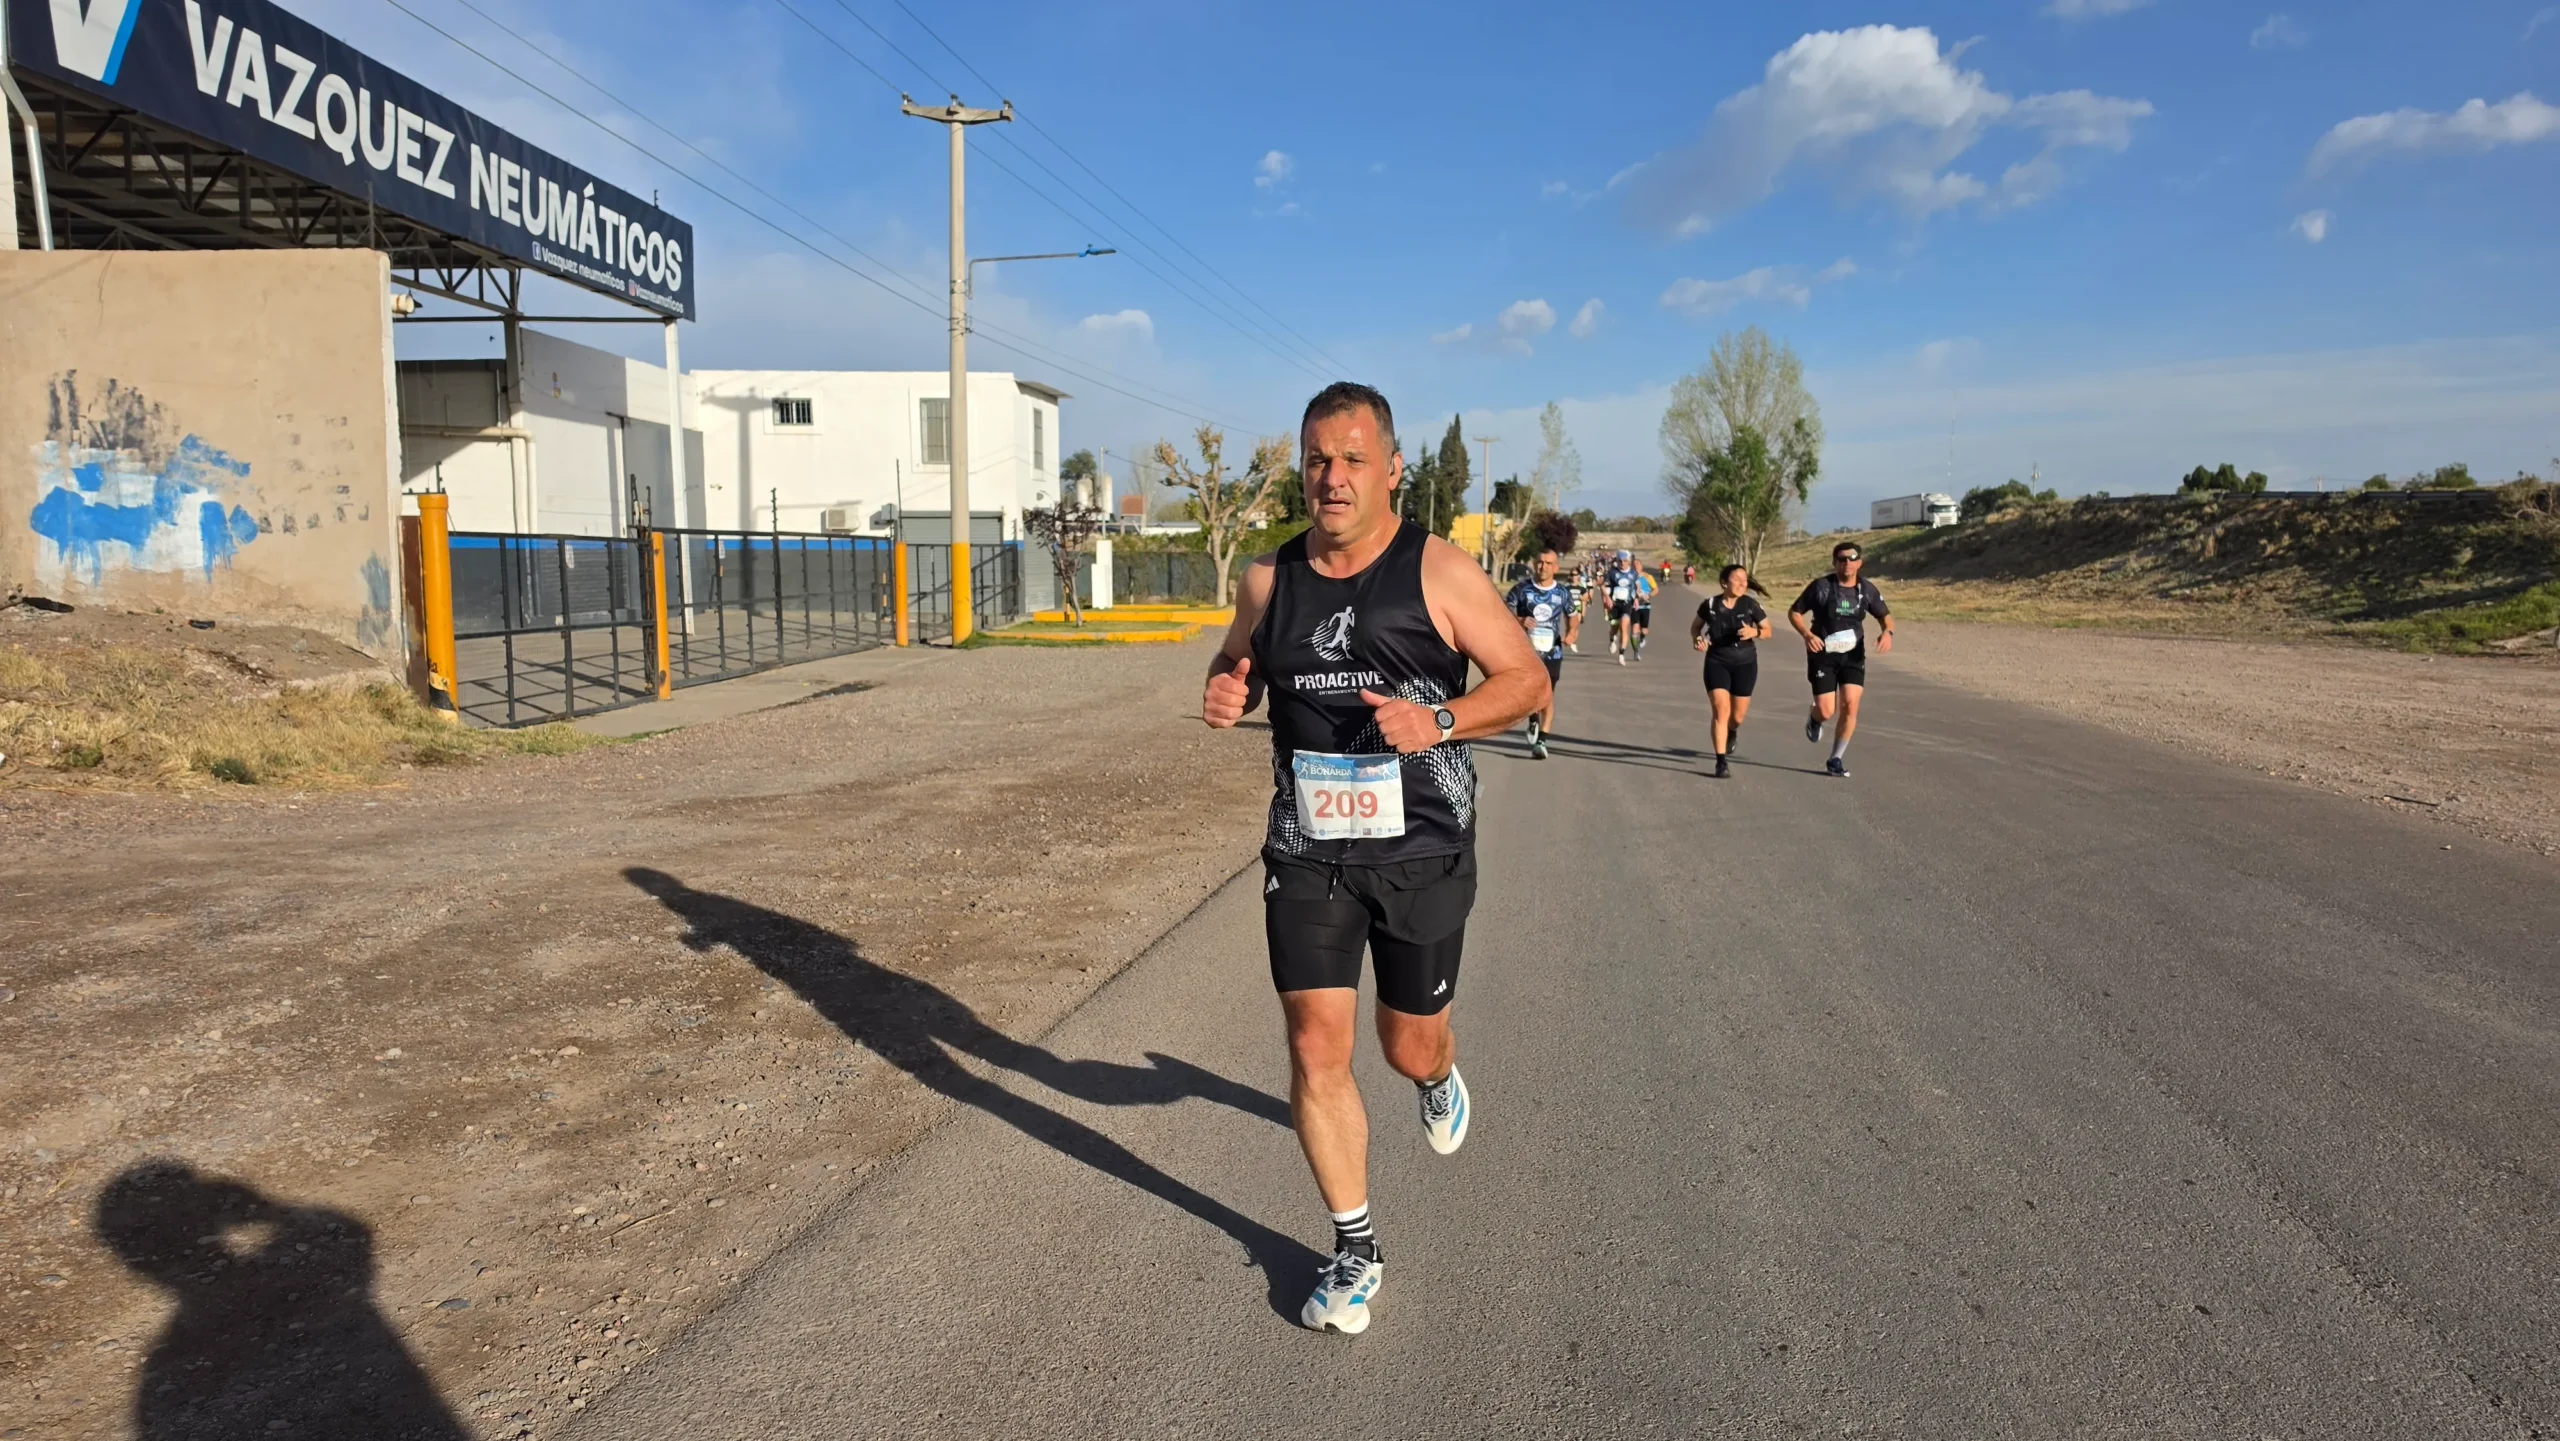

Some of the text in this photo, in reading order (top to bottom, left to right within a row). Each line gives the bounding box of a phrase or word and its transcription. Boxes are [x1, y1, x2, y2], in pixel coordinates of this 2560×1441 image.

[185, 0, 683, 292] VAZQUEZ NEUMÁTICOS
[542, 246, 578, 273] Vazquez
[1294, 671, 1384, 689] PROACTIVE
[1310, 767, 1353, 776] BONARDA
[1314, 789, 1378, 818] 209
